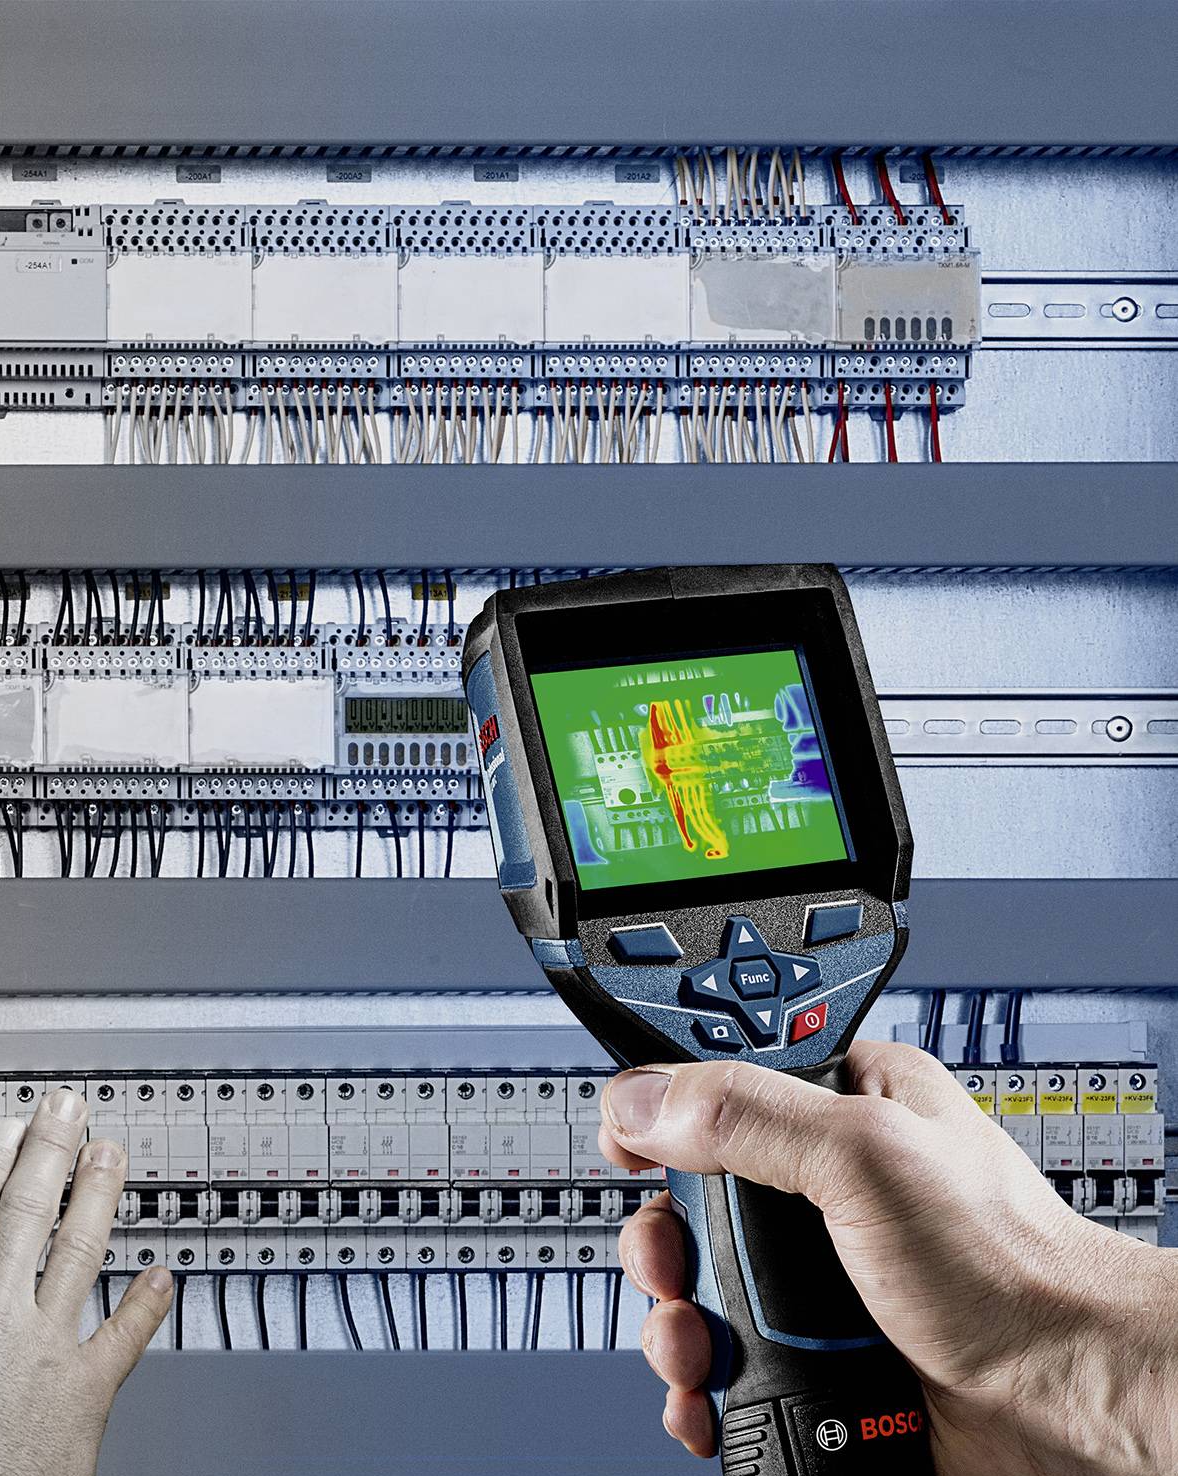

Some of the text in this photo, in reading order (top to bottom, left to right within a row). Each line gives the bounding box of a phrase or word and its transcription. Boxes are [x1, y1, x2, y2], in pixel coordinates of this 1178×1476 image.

[336, 172, 363, 180] -200A2
[483, 172, 510, 180] -201A1
[624, 172, 652, 181] -201A2
[25, 261, 52, 269] -254A1
[740, 972, 771, 985] Func
[861, 1410, 921, 1440] BOSC
